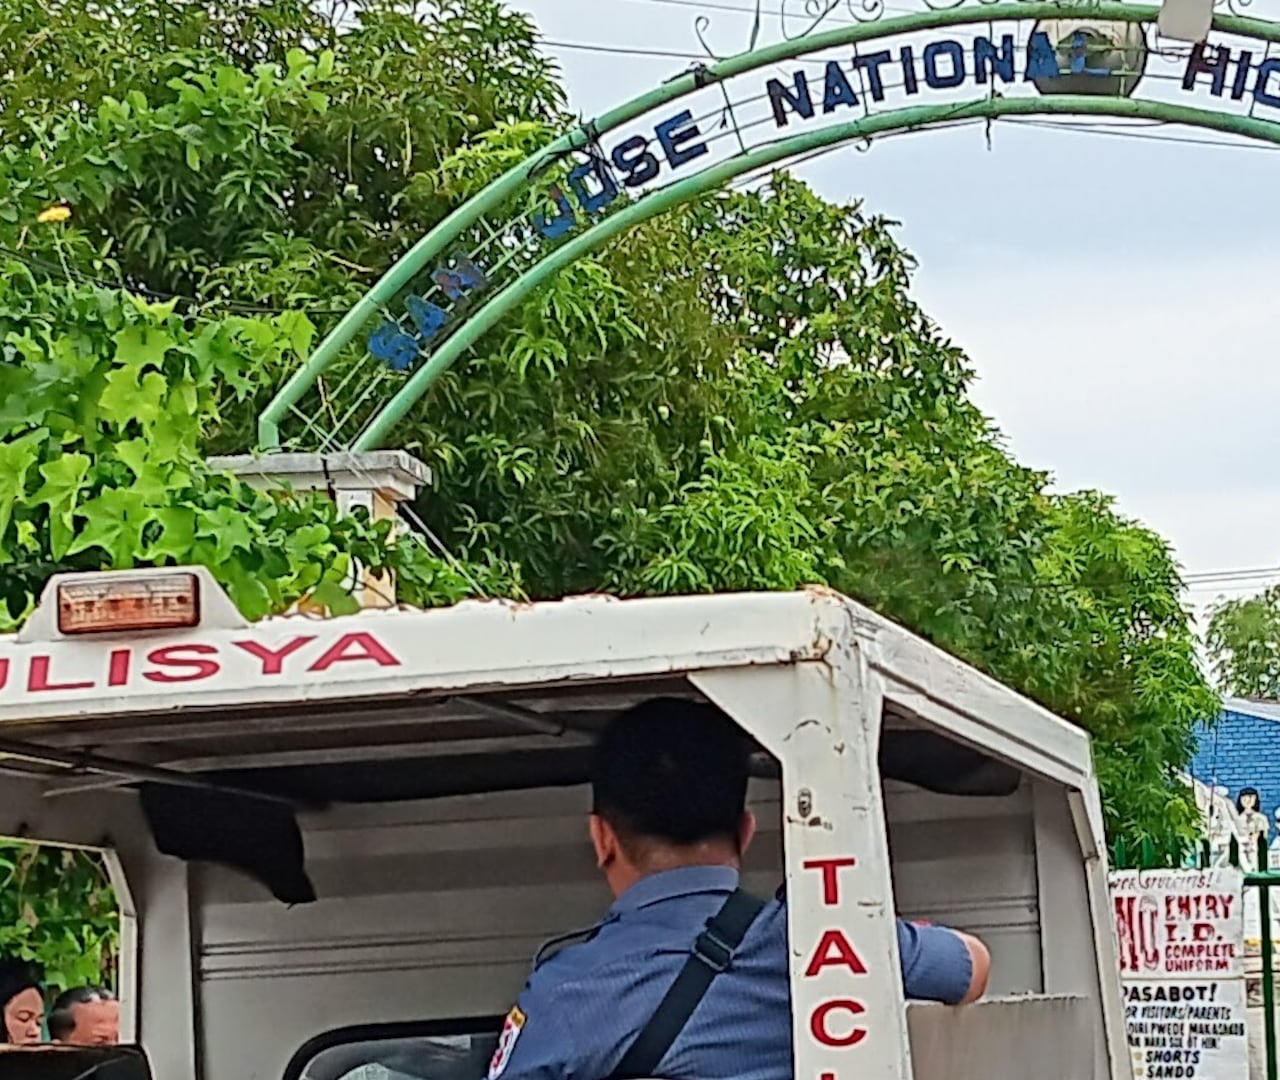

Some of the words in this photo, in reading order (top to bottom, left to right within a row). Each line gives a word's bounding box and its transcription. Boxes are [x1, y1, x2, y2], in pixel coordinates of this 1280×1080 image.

[534, 109, 709, 239] JOSE
[766, 30, 1111, 128] NATIONAL
[1114, 896, 1160, 972] NO
[1165, 894, 1235, 920] ENTRY
[1165, 943, 1237, 959] COMPLETE
[1165, 959, 1230, 972] UNIFORM
[1145, 1050, 1201, 1064] SHORTS
[1146, 1065, 1195, 1079] SANDO
